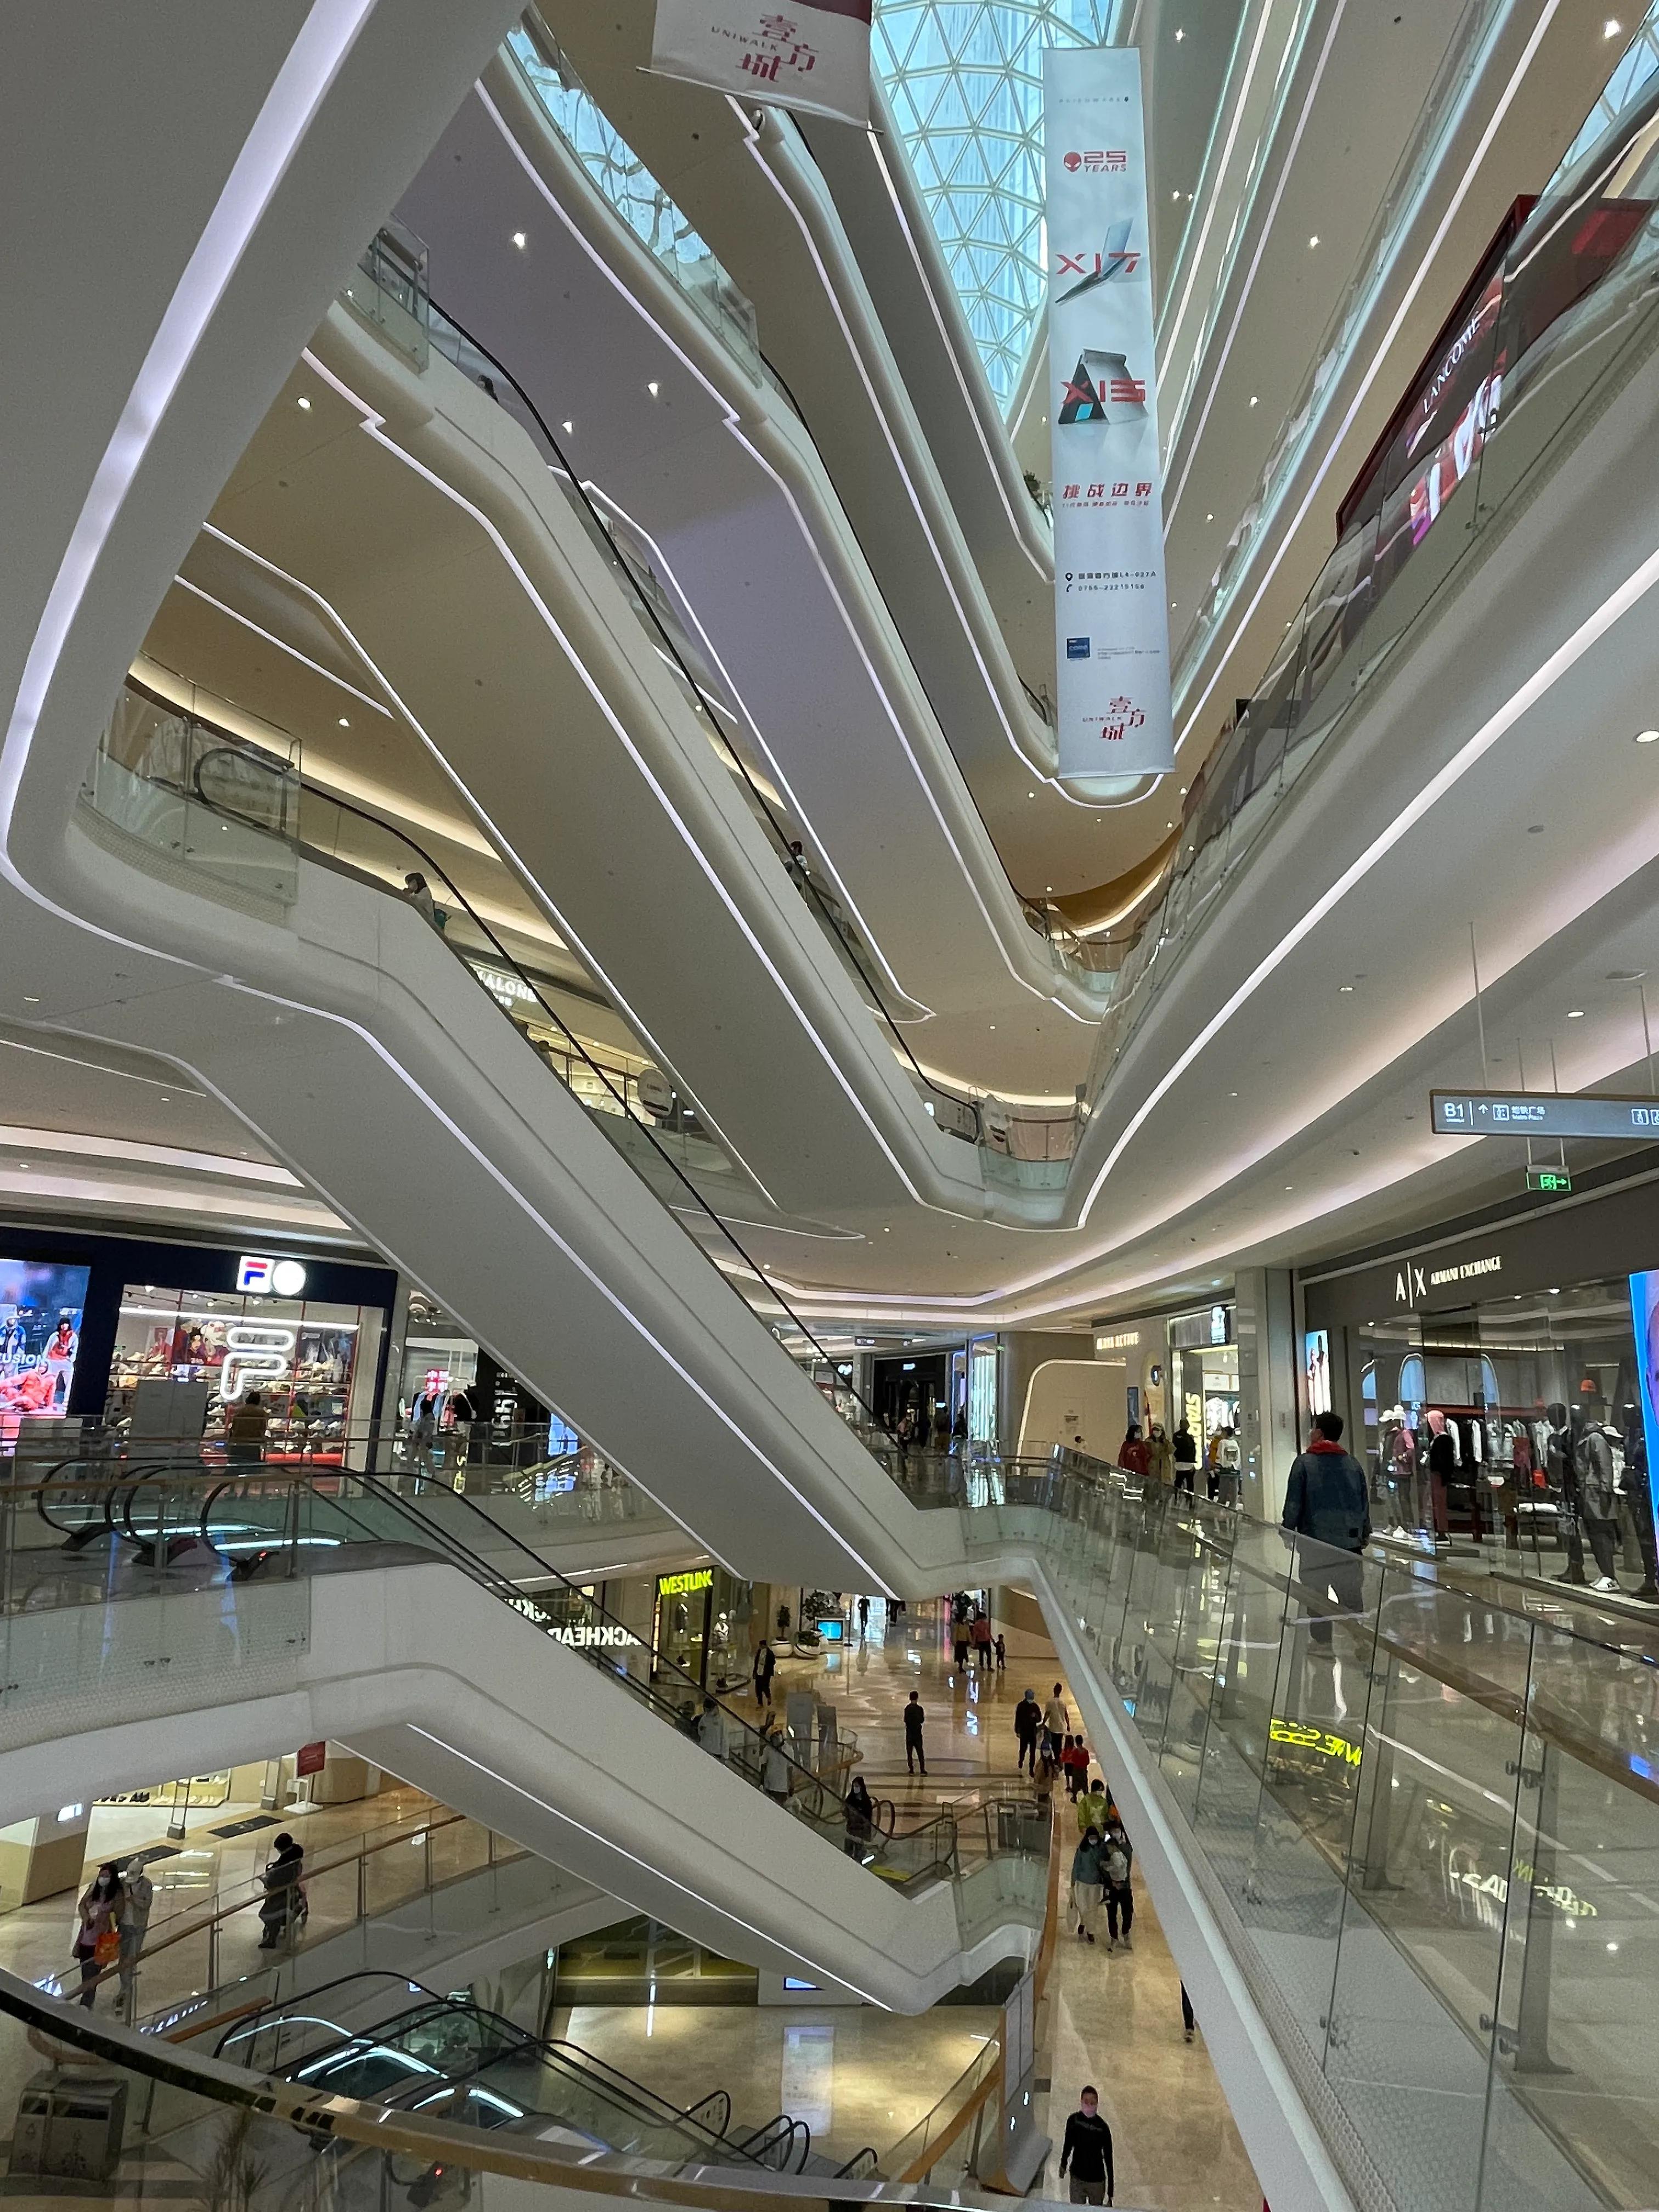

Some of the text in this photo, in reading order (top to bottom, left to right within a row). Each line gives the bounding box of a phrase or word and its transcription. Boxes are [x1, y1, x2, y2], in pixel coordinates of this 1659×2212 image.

[711, 26, 778, 52] UNIWALK
[1084, 150, 1127, 163] 25
[1084, 164, 1127, 172] YEARS
[1062, 483, 1152, 499] 挑战边界
[1444, 1103, 1464, 1118] B1
[1431, 1267, 1458, 1285] ARMANI
[1459, 1255, 1502, 1279] EXCHANGE
